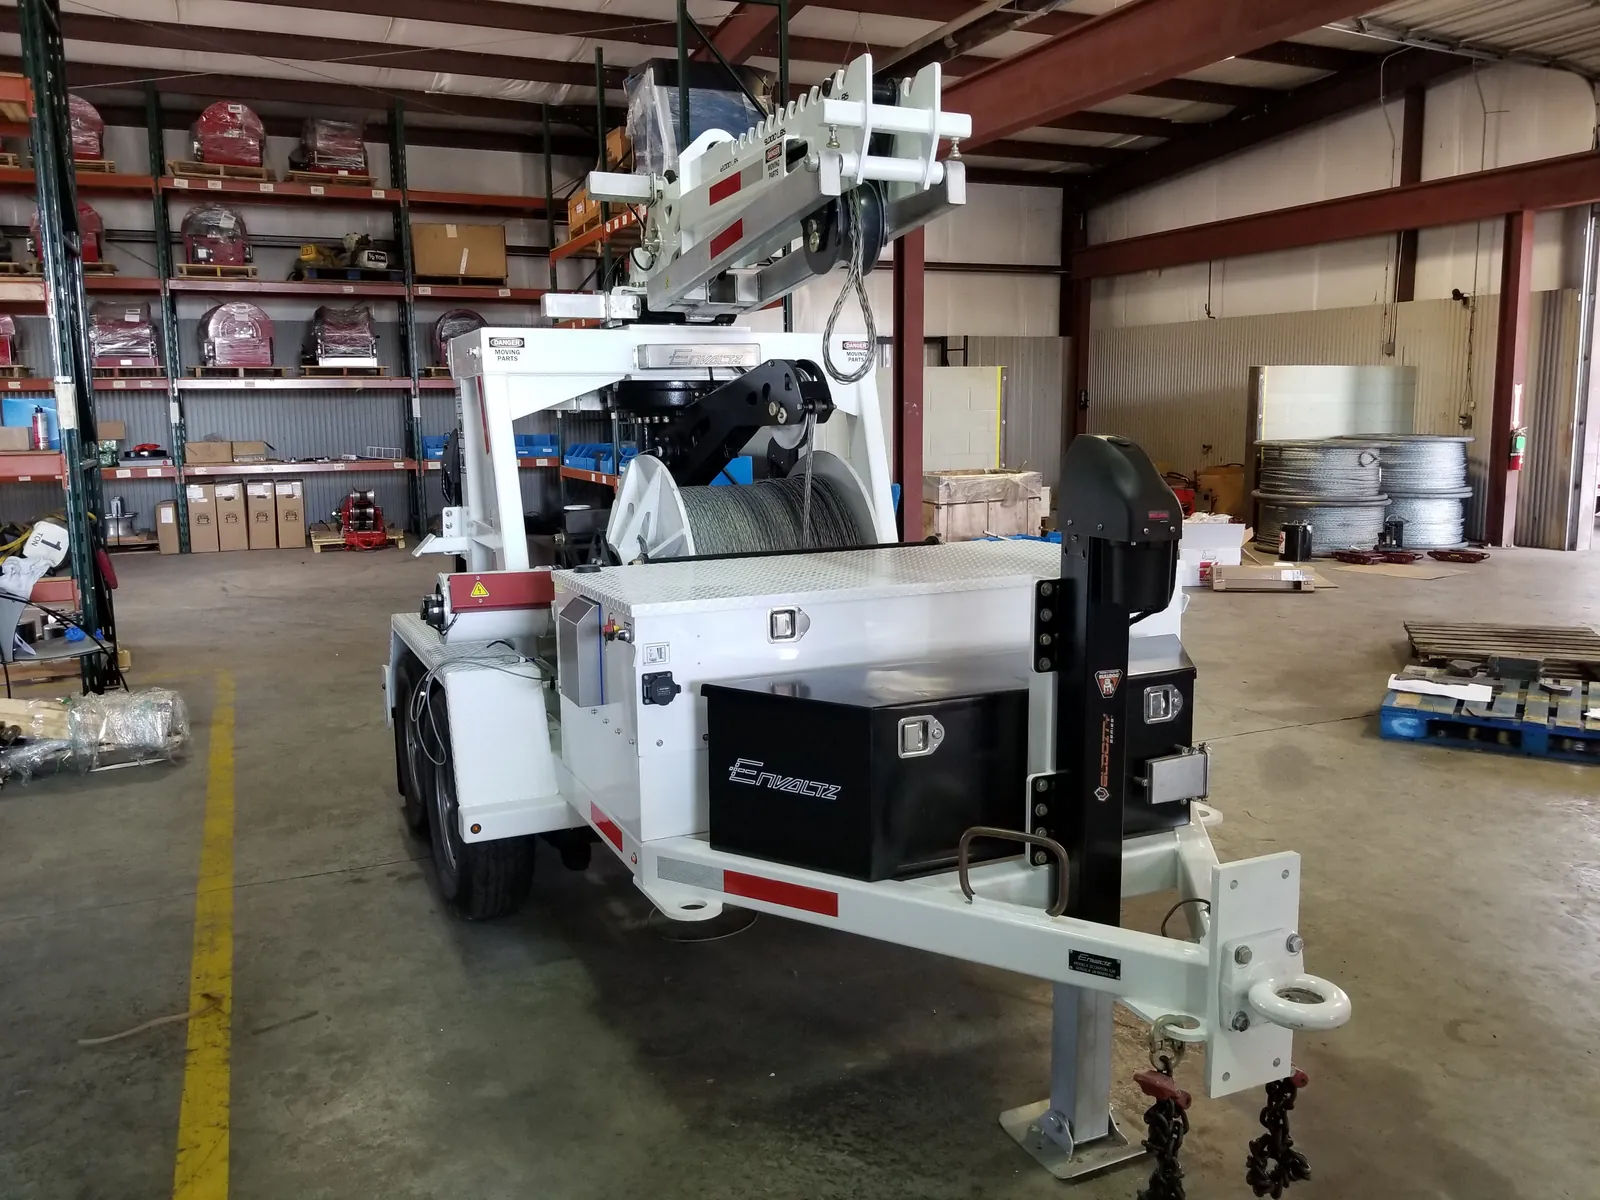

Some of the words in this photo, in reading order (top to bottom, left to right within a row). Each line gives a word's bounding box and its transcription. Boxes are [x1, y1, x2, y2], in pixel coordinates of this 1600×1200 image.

[494, 339, 520, 347] DANGER
[31, 532, 44, 547] TON
[41, 539, 62, 551] 1
